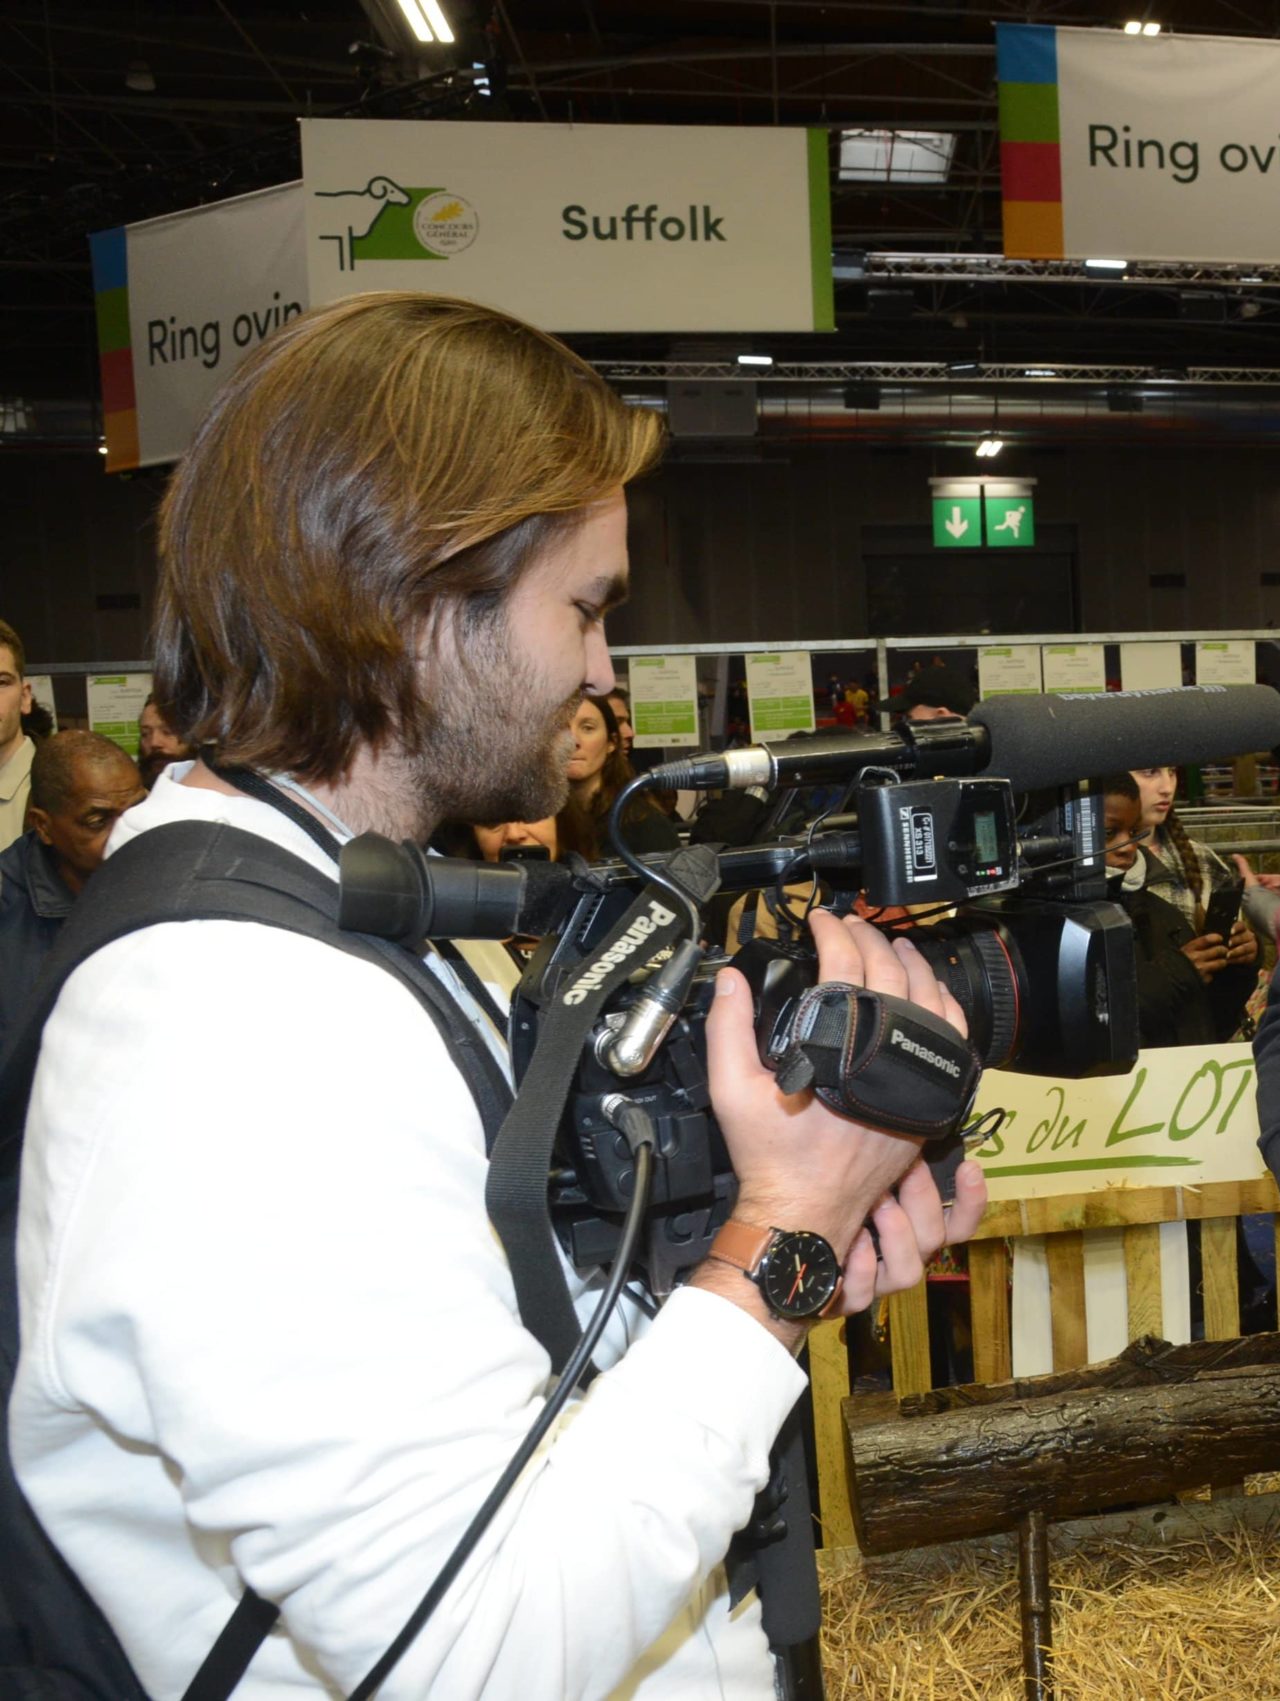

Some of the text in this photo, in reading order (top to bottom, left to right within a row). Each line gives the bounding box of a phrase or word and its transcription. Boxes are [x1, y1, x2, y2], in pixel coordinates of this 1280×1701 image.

[1088, 124, 1200, 184] Ring
[562, 204, 727, 242] Suffolk
[148, 316, 221, 369] Ring
[901, 819, 914, 884] SENNHEISER
[563, 900, 677, 1006] Panasonic
[890, 1028, 961, 1079] Panasonic
[1026, 1086, 1088, 1153] du
[1105, 1058, 1256, 1147] LOT
